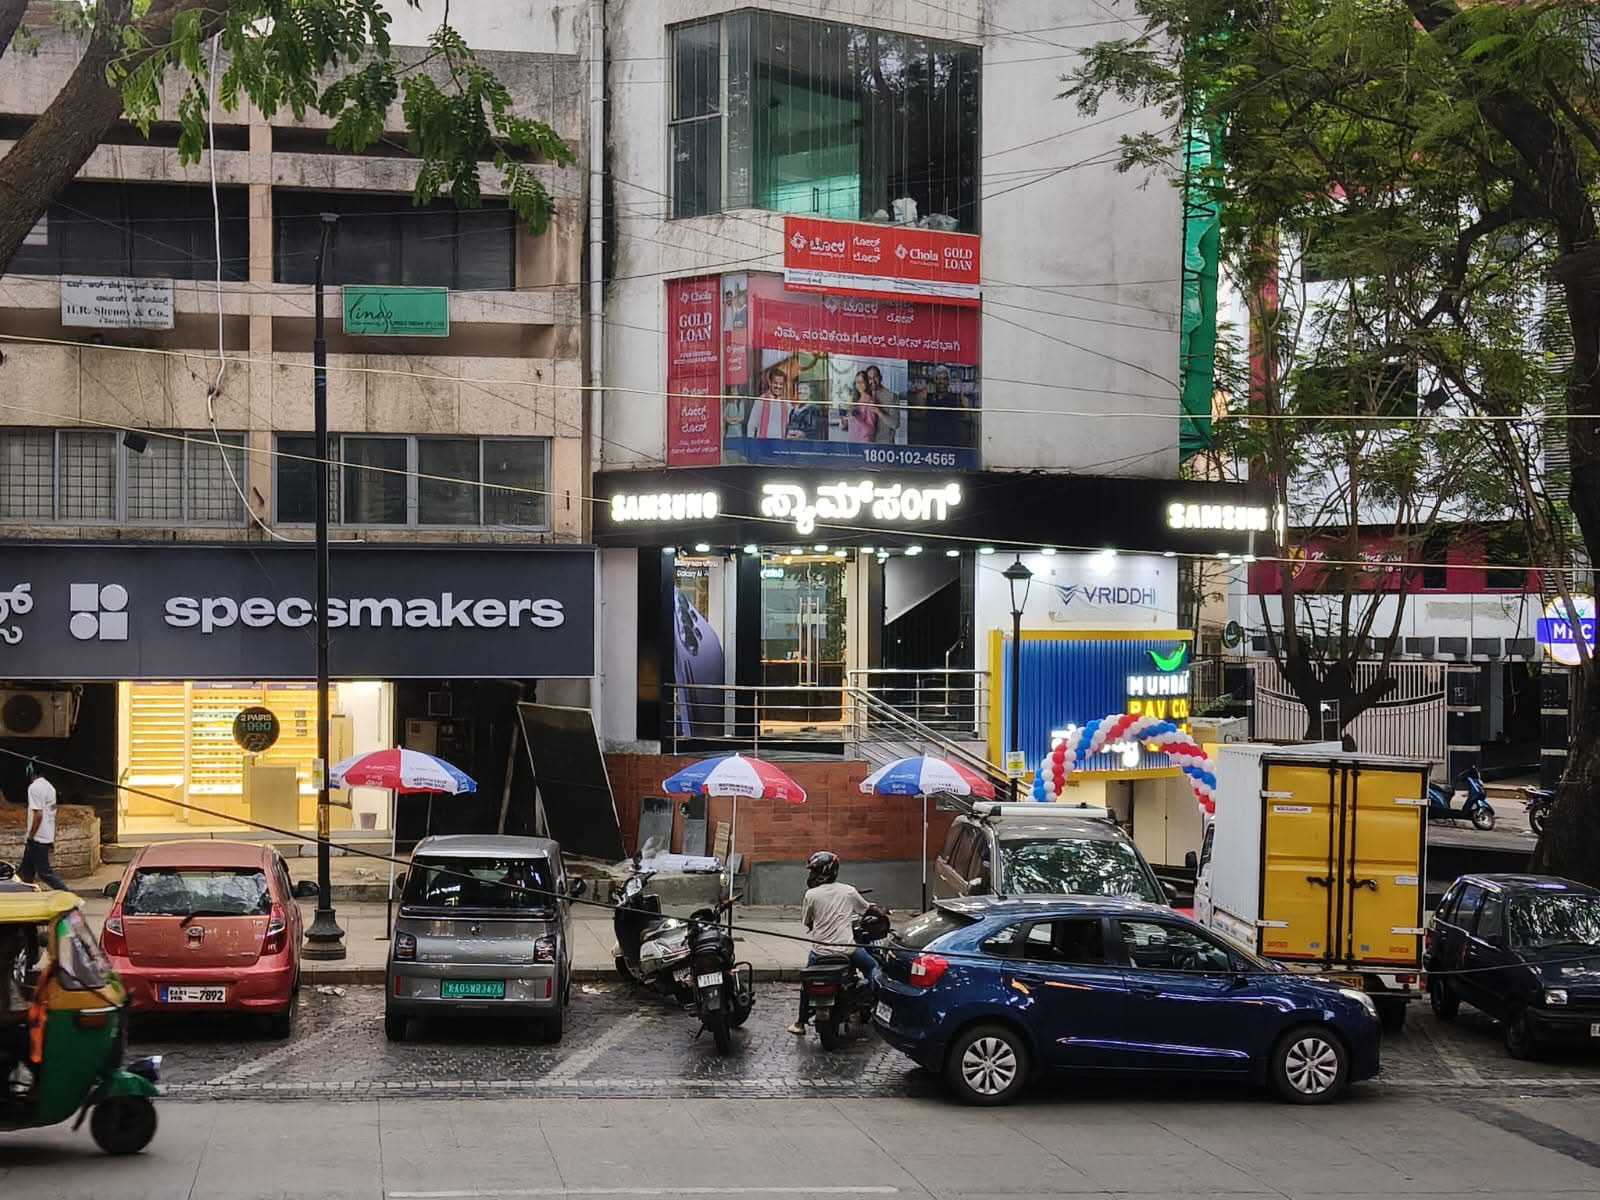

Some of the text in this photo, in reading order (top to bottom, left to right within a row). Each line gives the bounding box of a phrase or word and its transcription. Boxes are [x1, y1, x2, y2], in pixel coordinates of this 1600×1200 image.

[909, 248, 938, 261] Chola
[944, 247, 973, 260] GOLD
[945, 259, 973, 270] LOAN
[679, 311, 712, 329] GOLD
[680, 325, 712, 342] LOAN
[864, 449, 956, 466] 1800-102-4565
[611, 492, 718, 521] SAMSUNG
[1084, 586, 1156, 606] VRIDDHI
[200, 990, 223, 1000] 7892
